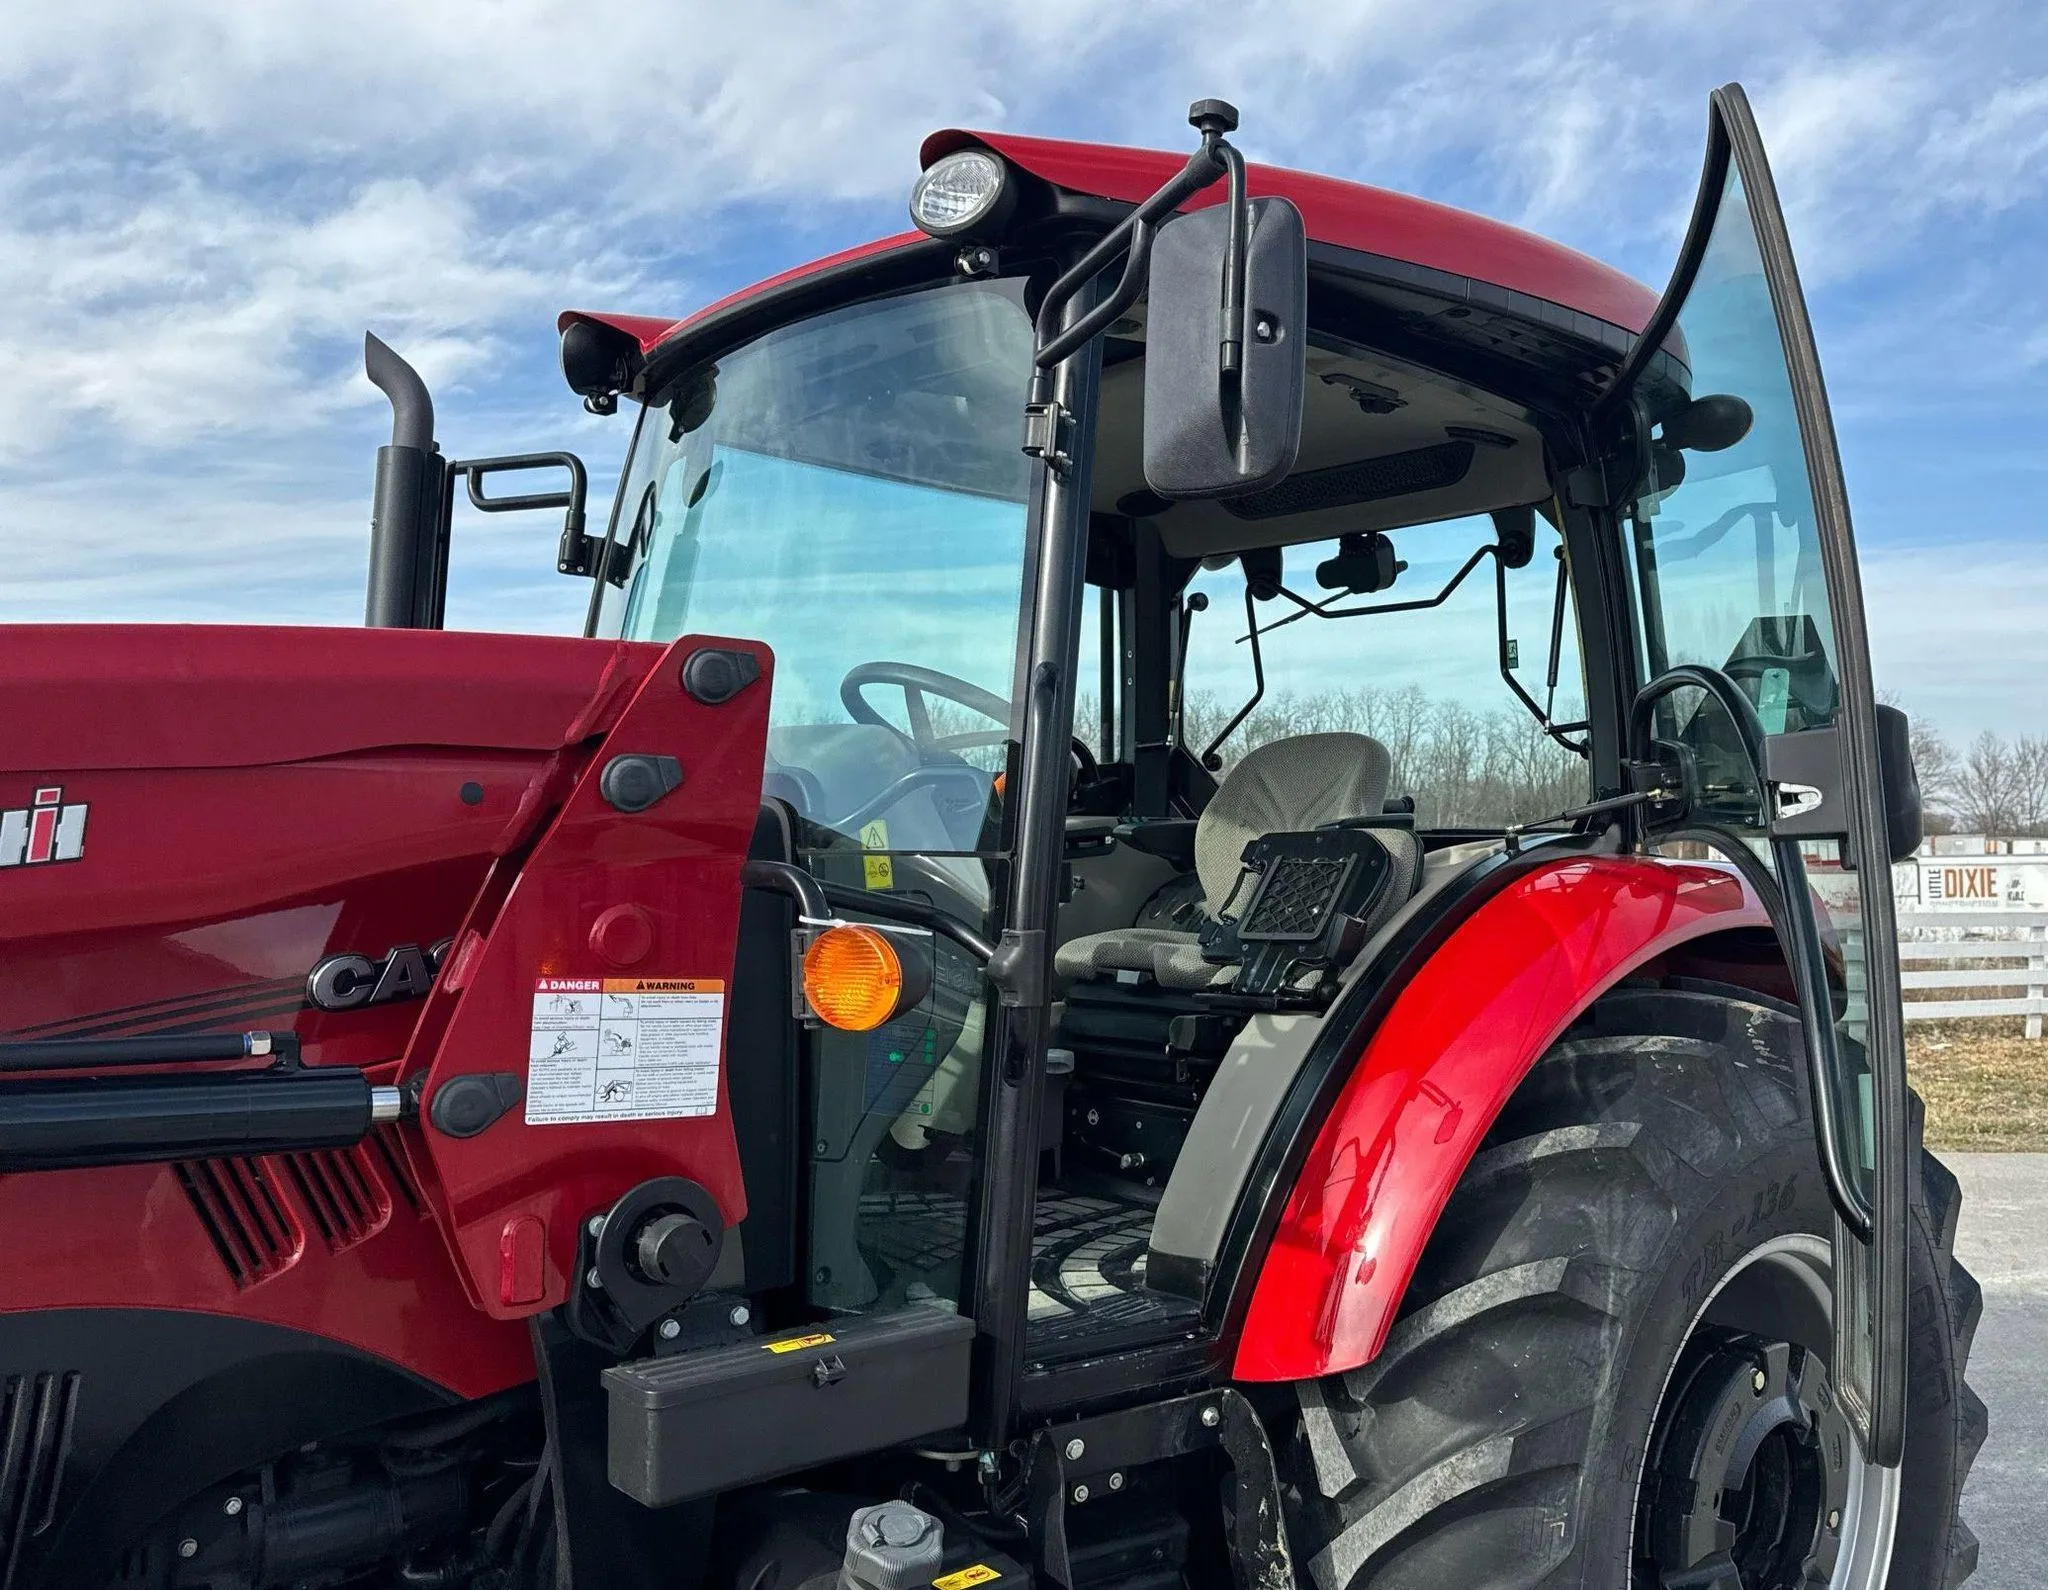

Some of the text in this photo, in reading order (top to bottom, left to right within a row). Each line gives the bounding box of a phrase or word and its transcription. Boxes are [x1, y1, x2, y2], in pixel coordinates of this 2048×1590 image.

[1928, 868, 1942, 899] LITTLE
[1944, 868, 1998, 898] DIXIE
[306, 934, 457, 1012] CA
[550, 981, 600, 990] DANGER
[646, 981, 695, 990] WARNING
[528, 1115, 548, 1123] Failure
[558, 1114, 580, 1123] comply
[581, 1113, 594, 1121] may
[620, 1110, 637, 1118] death
[645, 1109, 665, 1117] serious
